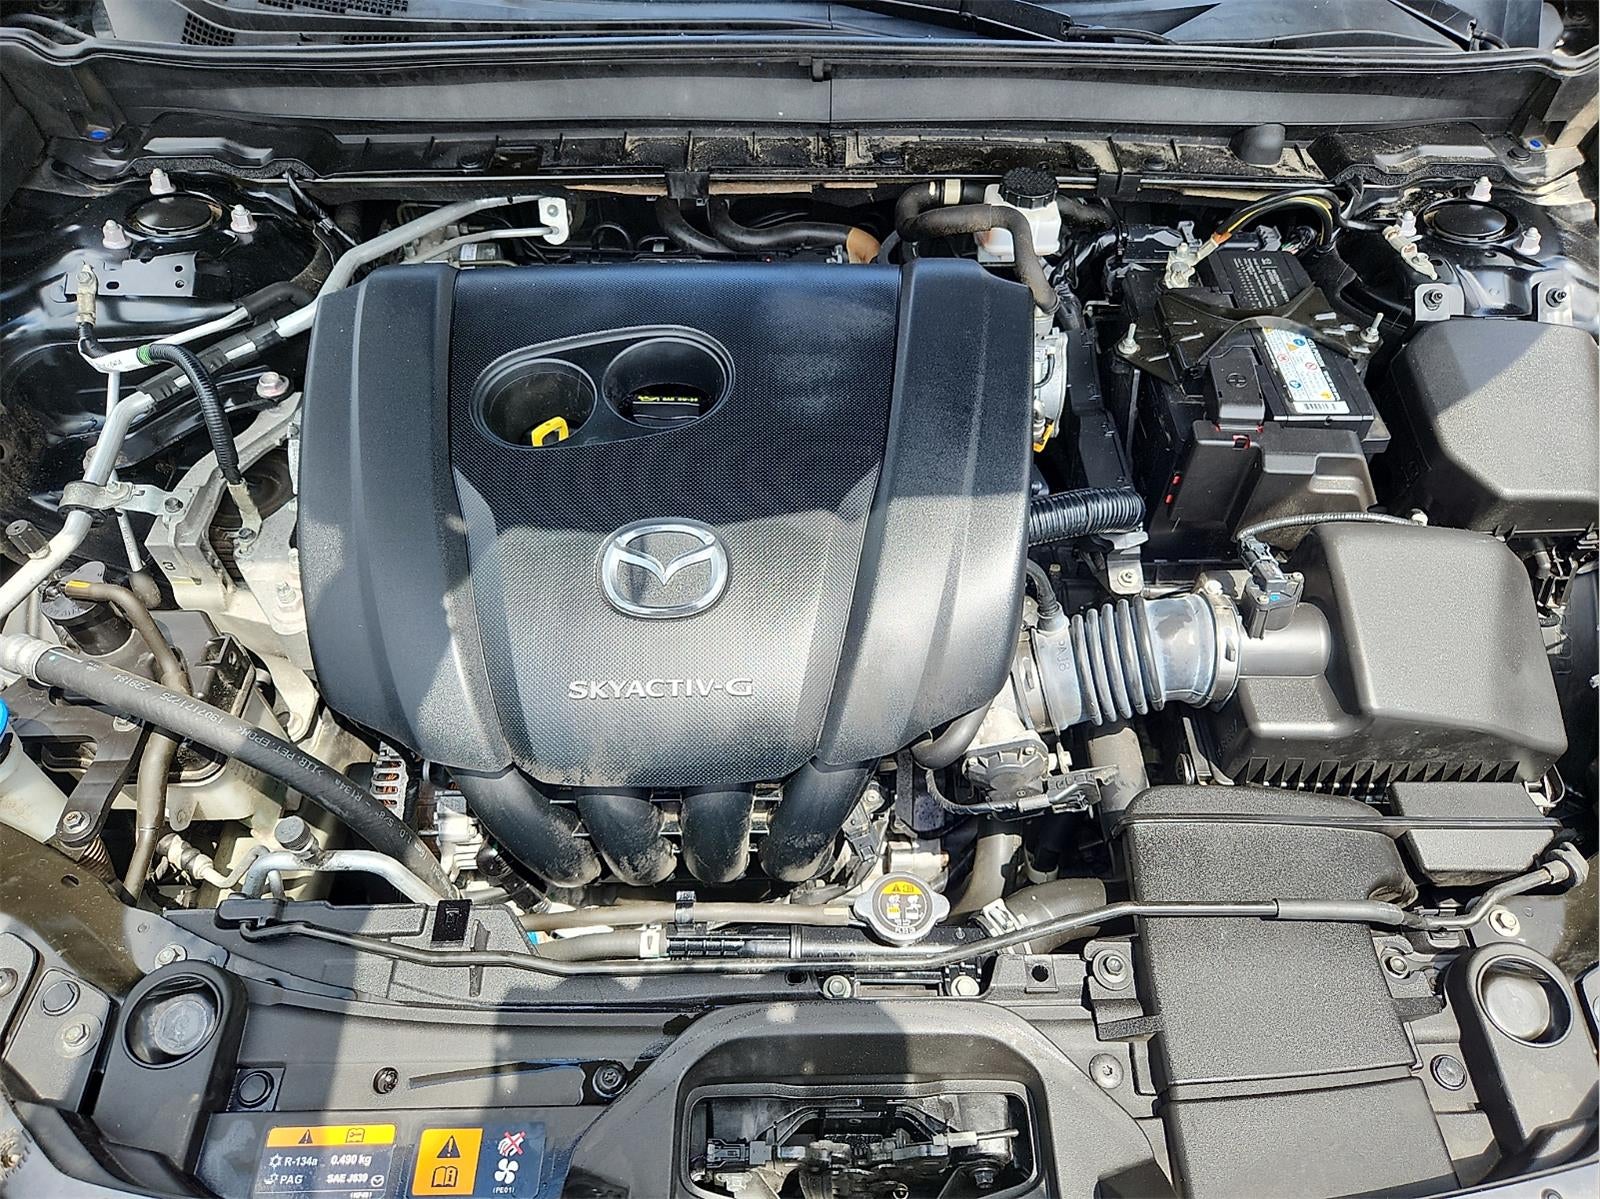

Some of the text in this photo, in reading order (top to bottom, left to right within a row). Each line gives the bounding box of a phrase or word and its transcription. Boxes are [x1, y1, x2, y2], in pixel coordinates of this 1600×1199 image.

[568, 678, 753, 700] SKYACTIV-G
[335, 778, 363, 802] R134a
[284, 1154, 372, 1167] R-134a 0.490 kg
[279, 1174, 304, 1185] PAG
[326, 1173, 346, 1184] SAE
